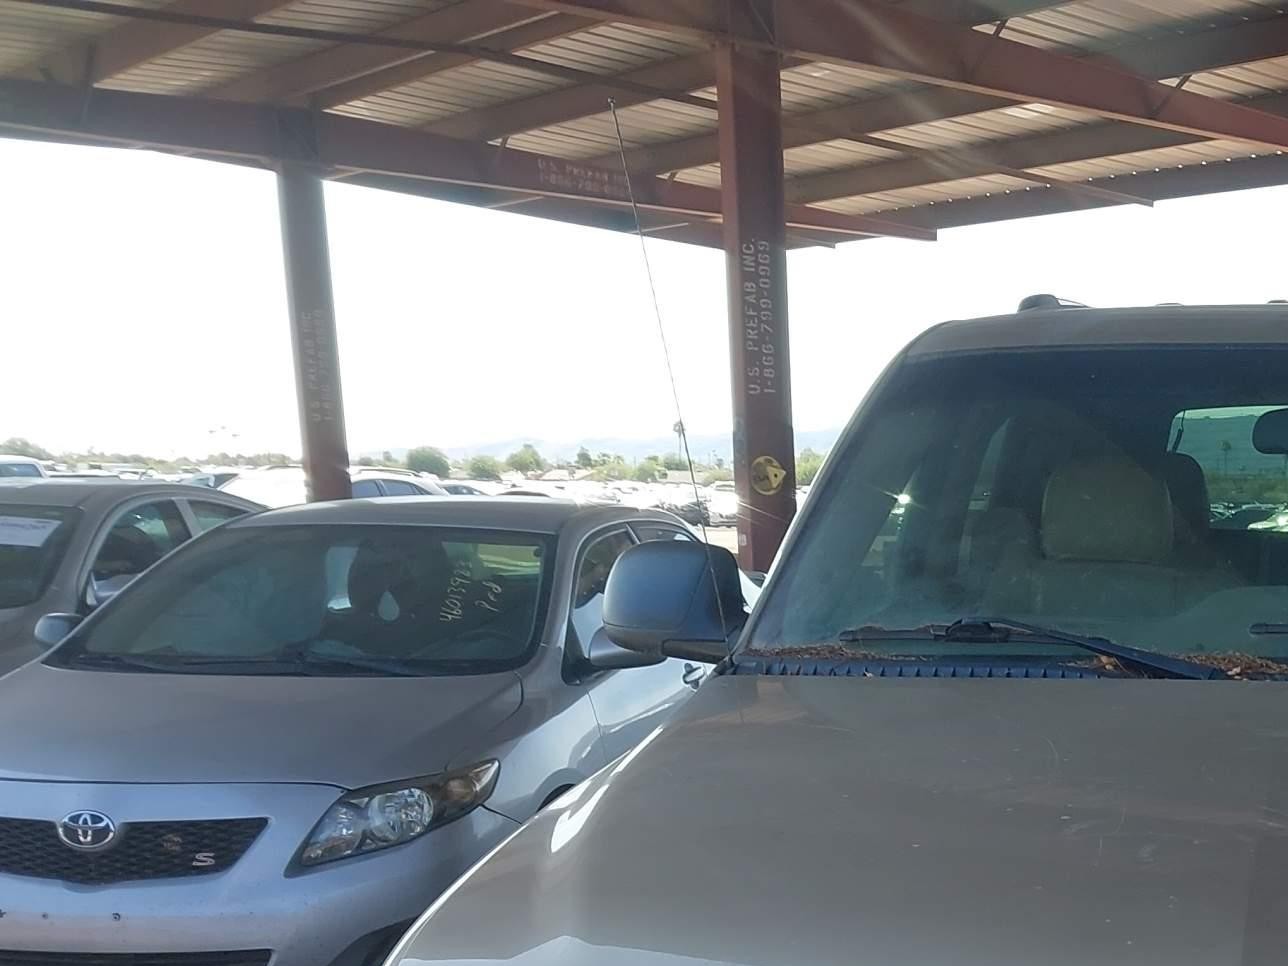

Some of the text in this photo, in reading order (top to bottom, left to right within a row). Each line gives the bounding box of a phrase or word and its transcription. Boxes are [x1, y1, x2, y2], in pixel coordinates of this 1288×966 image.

[742, 238, 761, 394] U.S. PREFAB INC.
[758, 241, 776, 393] 1-866-799-0969
[192, 852, 216, 866] S
